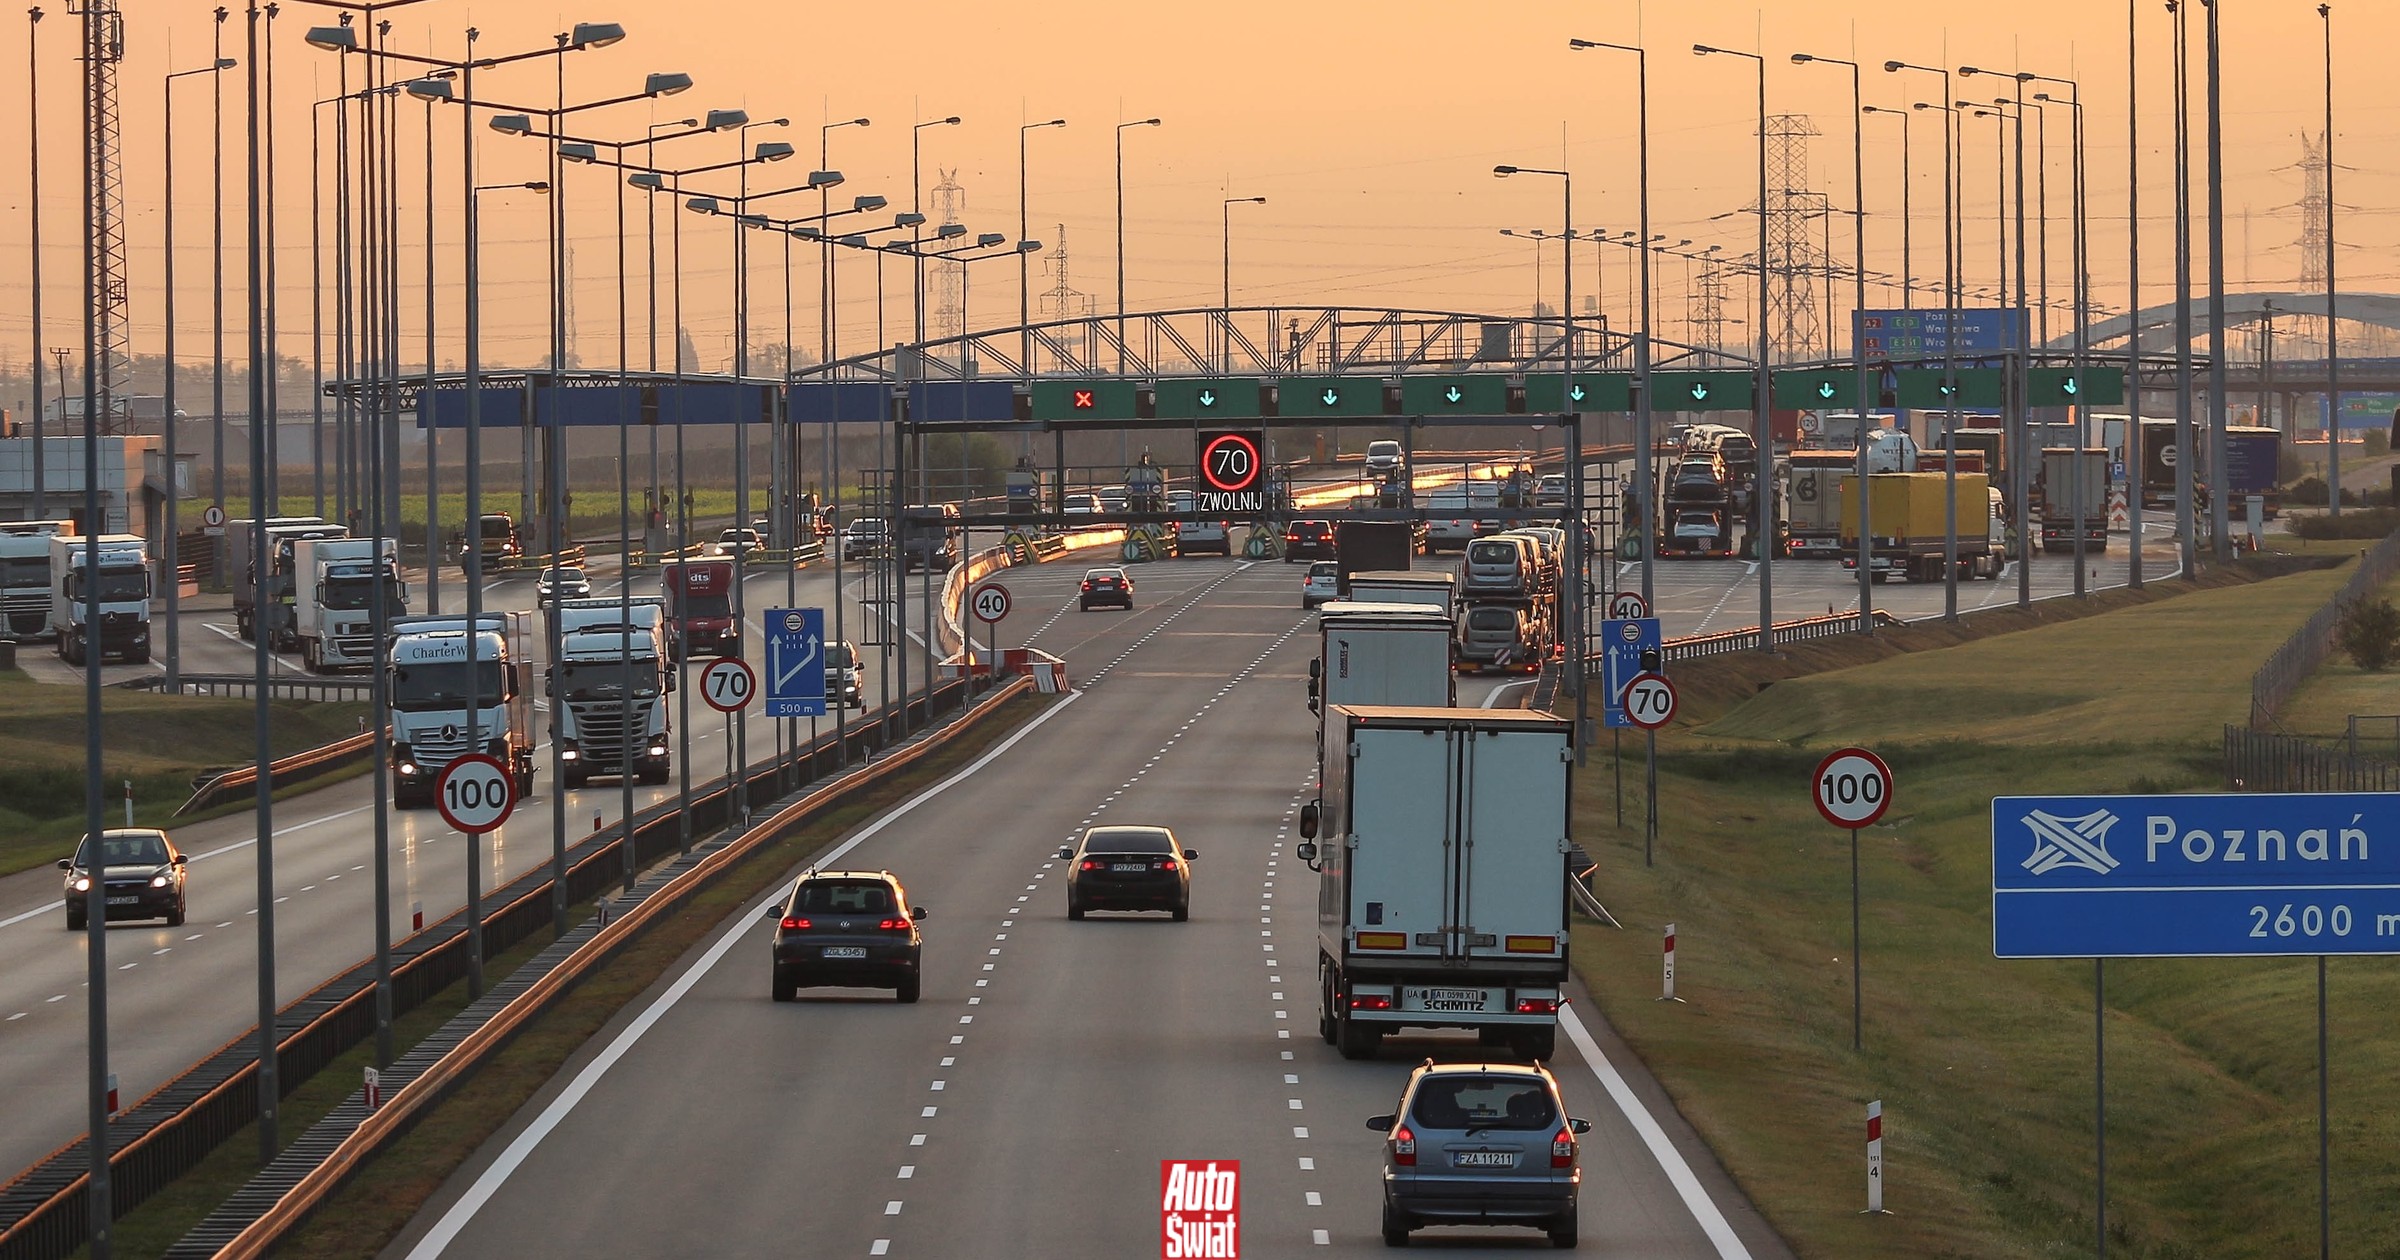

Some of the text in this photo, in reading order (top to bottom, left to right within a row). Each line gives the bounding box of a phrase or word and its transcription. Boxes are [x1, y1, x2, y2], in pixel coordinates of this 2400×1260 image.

[1215, 449, 1247, 475] 70
[1200, 492, 1262, 511] ZWOLNIJ
[690, 573, 709, 582] dts
[979, 594, 1004, 613] 40
[1617, 602, 1642, 618] 40
[412, 645, 480, 659] CharterW
[712, 671, 748, 698] 70
[780, 703, 813, 713] 500 m
[1635, 688, 1670, 715] 70
[446, 778, 506, 810] 100
[1822, 773, 1882, 805] 100
[2146, 813, 2368, 863] Poznań
[2249, 904, 2400, 938] 2600 m
[1665, 970, 1672, 980] 5
[1407, 990, 1419, 999] UA
[1423, 1000, 1485, 1011] SCHMITZ
[1459, 1153, 1512, 1164] FZA 11211
[1870, 1166, 1879, 1178] 4
